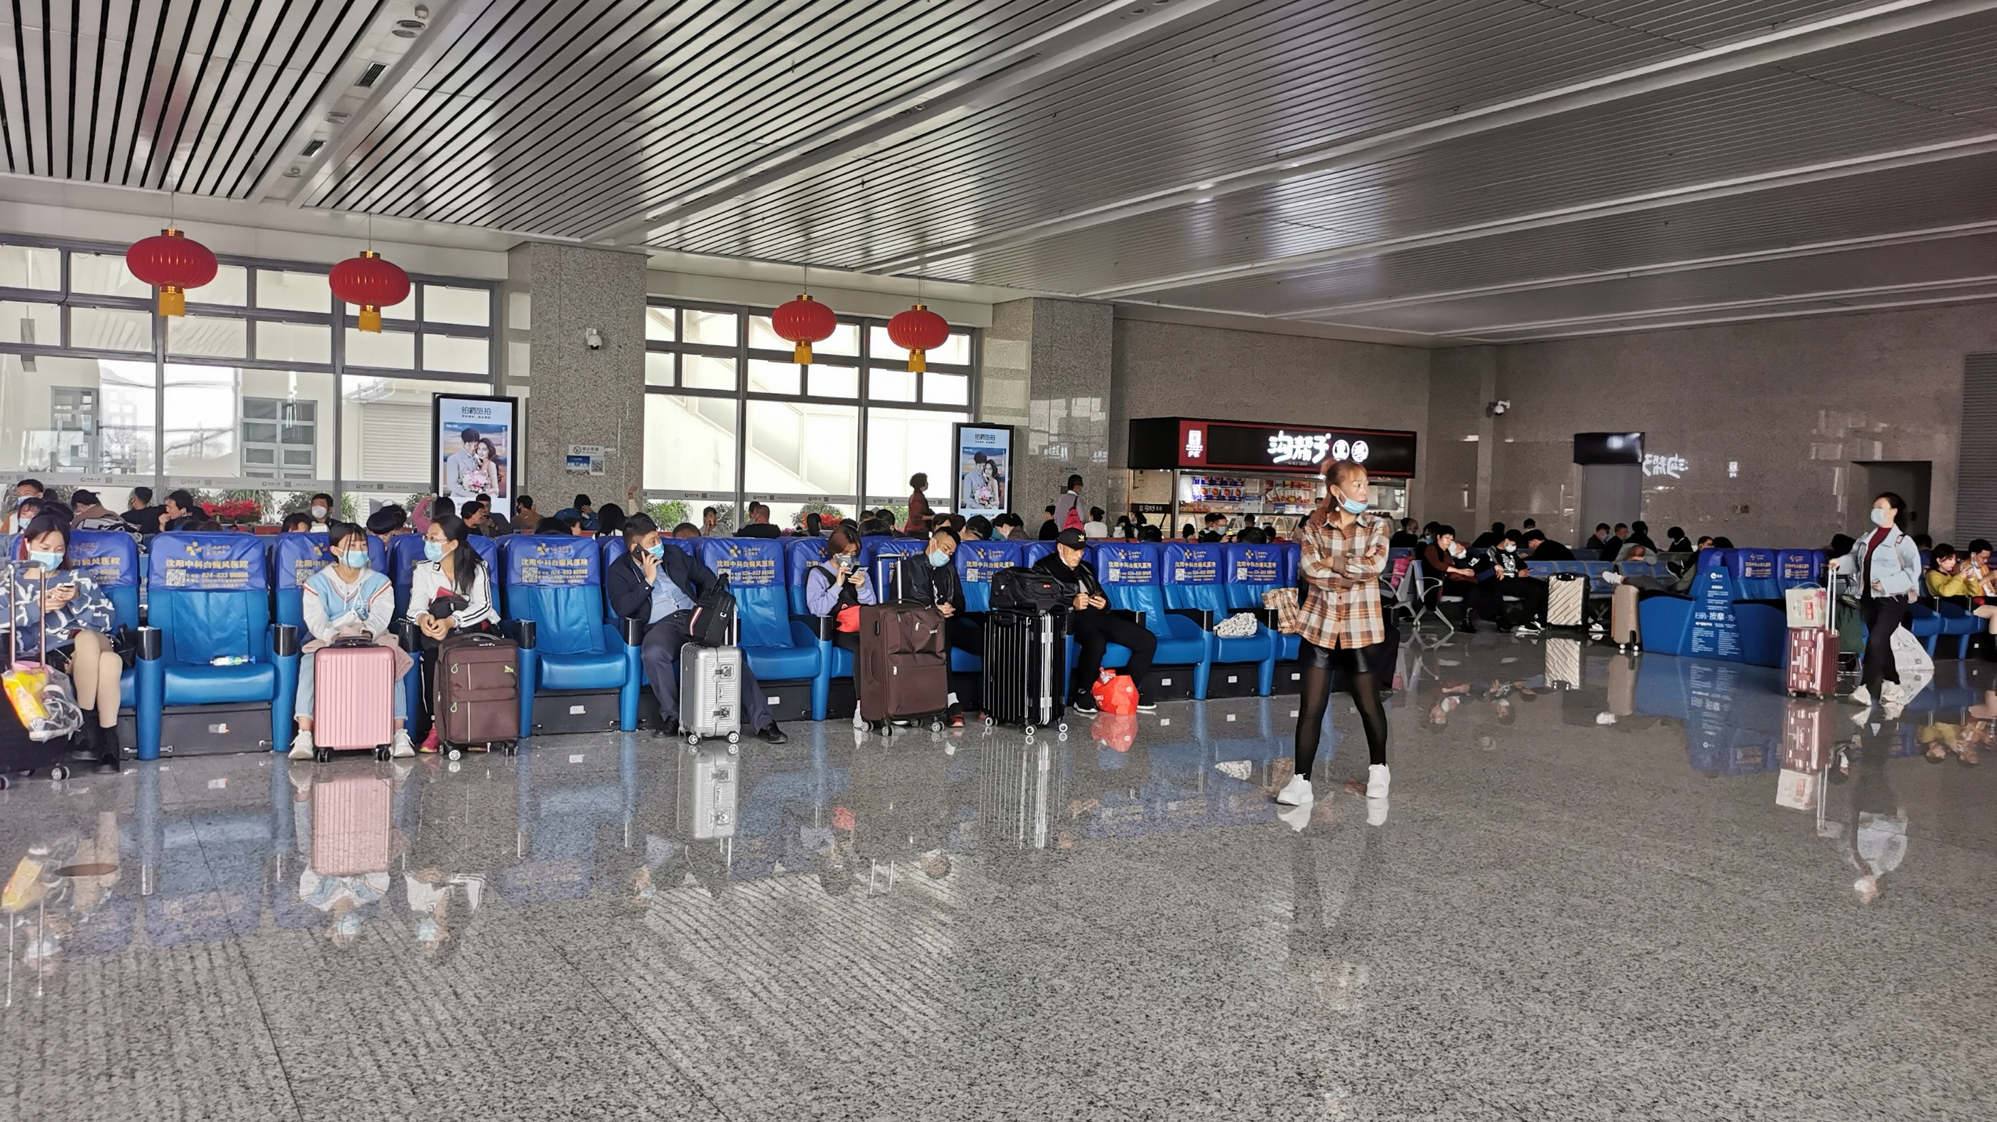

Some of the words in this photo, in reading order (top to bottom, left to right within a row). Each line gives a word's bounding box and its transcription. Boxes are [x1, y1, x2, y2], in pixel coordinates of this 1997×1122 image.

[1267, 430, 1330, 464] 沟帮子
[165, 558, 249, 569] 沈阳中科白癜风医院
